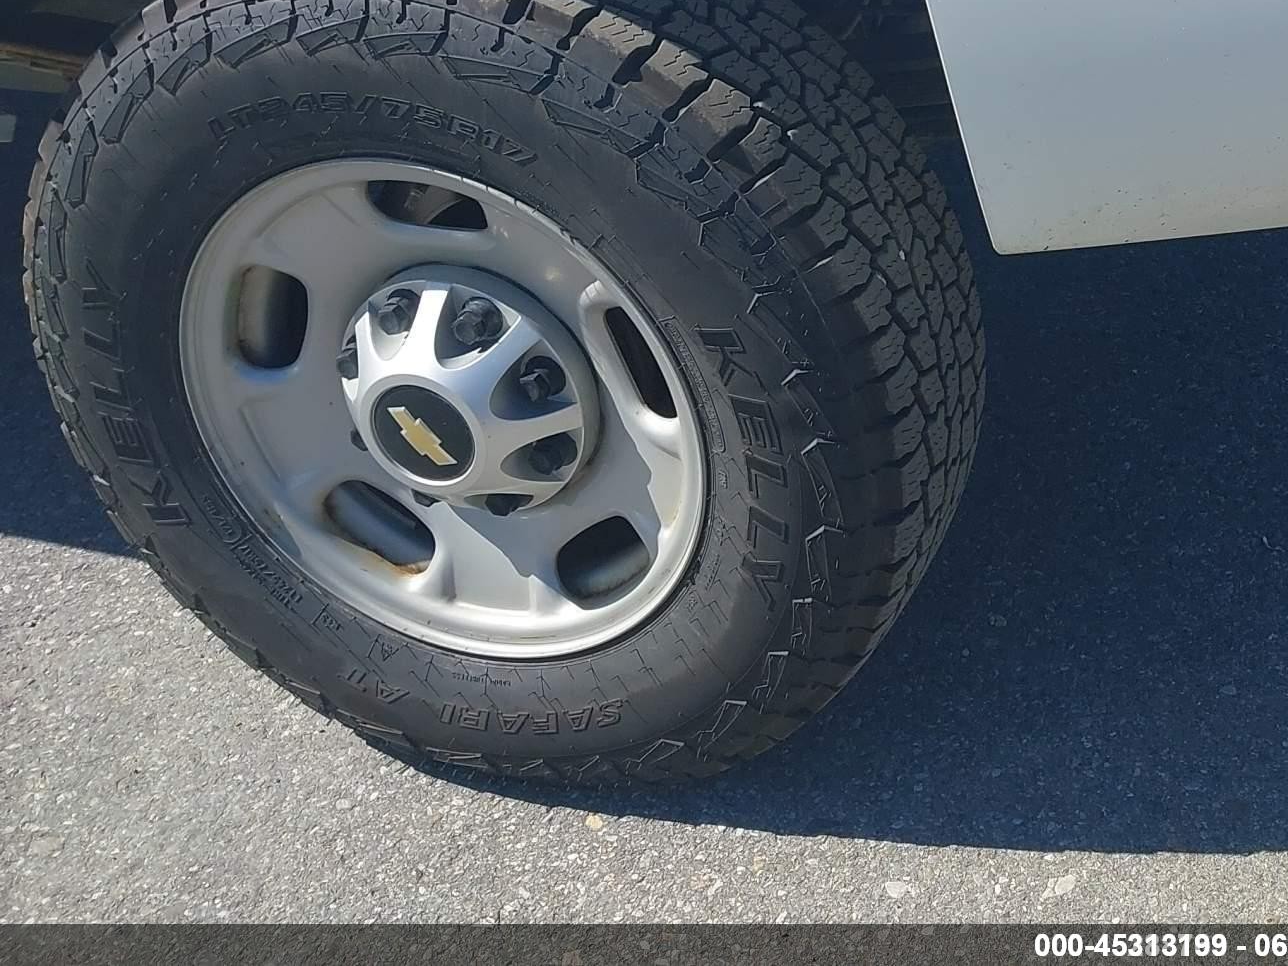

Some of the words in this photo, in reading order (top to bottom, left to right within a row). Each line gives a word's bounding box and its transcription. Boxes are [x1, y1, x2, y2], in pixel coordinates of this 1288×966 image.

[80, 256, 192, 528] KELLY
[694, 323, 790, 614] KELLY
[440, 697, 624, 735] SAFARI
